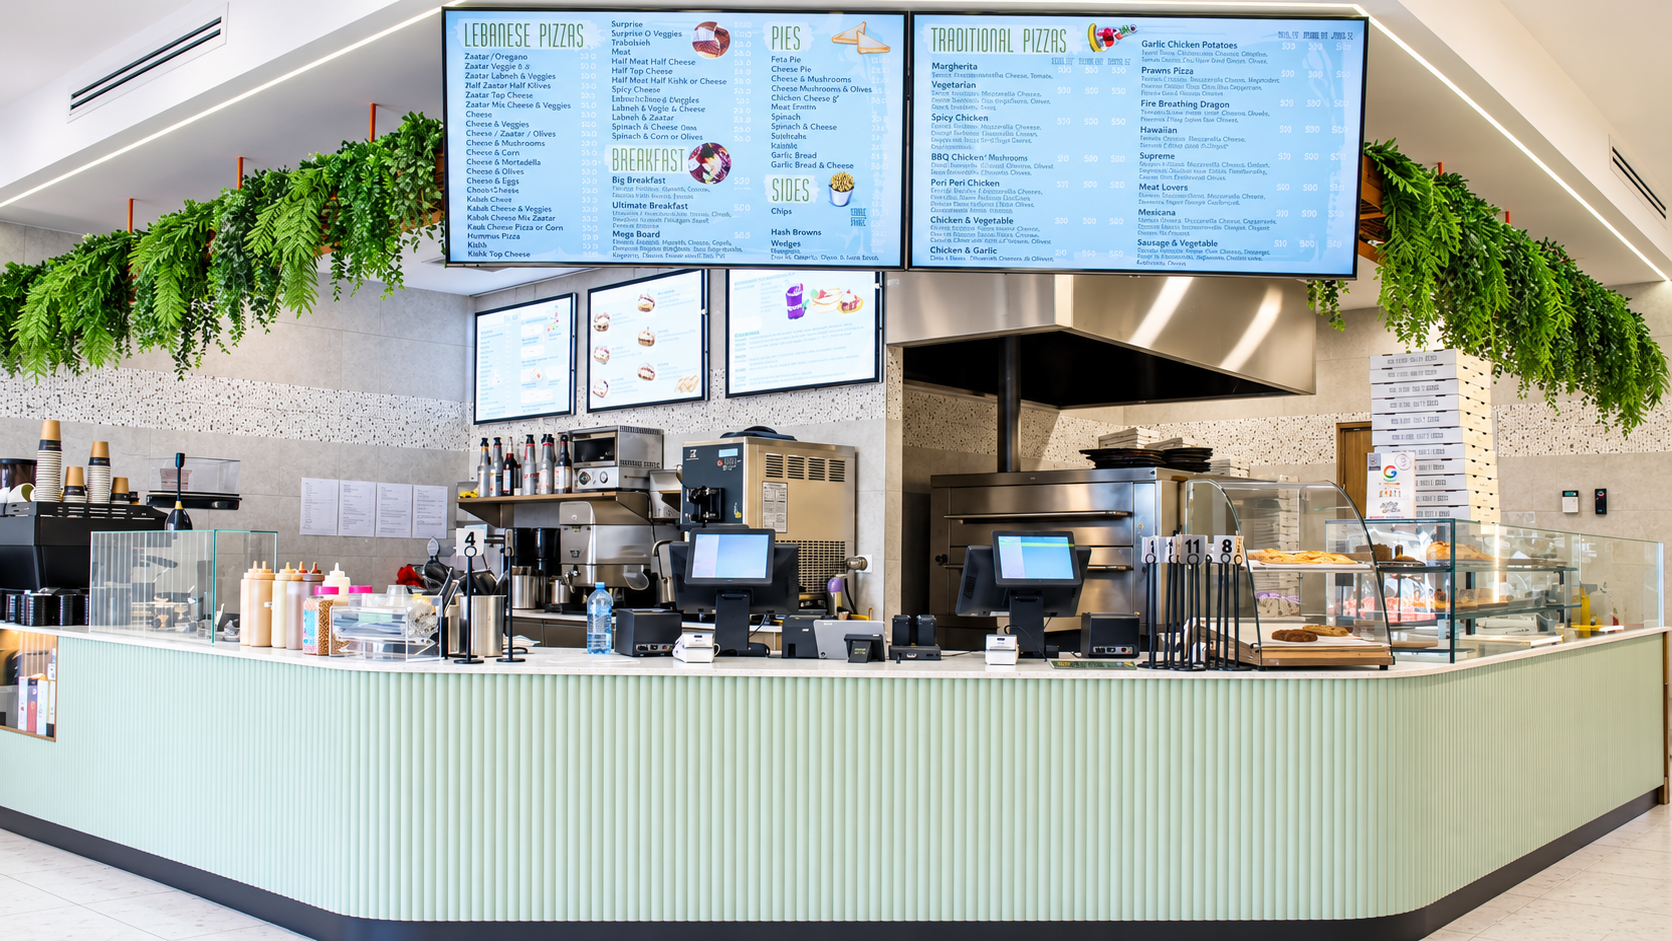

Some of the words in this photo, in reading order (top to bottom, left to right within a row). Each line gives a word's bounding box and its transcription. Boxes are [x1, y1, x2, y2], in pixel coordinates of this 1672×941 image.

[611, 20, 643, 28] Surprise
[464, 22, 530, 47] LEBANESE
[539, 23, 584, 47] PIZZAS
[611, 29, 643, 38] Surprise
[653, 30, 682, 39] Veggies
[771, 25, 801, 50] PIES
[931, 27, 1014, 52] TRADITIONAL
[1023, 28, 1067, 53] PIZZAS
[1141, 39, 1165, 48] Garlic
[1167, 40, 1200, 49] Chicken
[1202, 40, 1237, 49] Potatoes
[650, 57, 666, 65] Half
[771, 55, 787, 63] Feta
[789, 55, 801, 63] Pie
[629, 67, 644, 76] Top
[931, 62, 977, 72] Margherita
[1141, 66, 1171, 74] Prawns
[527, 72, 556, 81] Veggies
[650, 76, 666, 84] Half
[482, 81, 508, 89] Zaatar
[509, 81, 526, 89] Half
[611, 85, 632, 94] Spicy
[633, 85, 660, 93] Cheese
[771, 84, 798, 92] Cheese
[931, 80, 976, 90] Vegetarian
[491, 91, 505, 99] Top
[803, 94, 830, 102] Cheese
[465, 100, 490, 108] Zaatar
[542, 102, 571, 111] Veggies
[1140, 99, 1156, 107] Fire
[1158, 100, 1198, 109] Breathing
[1200, 100, 1229, 110] Dragon
[465, 110, 492, 118] Cheese
[612, 113, 639, 121] Labneh
[648, 113, 674, 121] Zaatar
[771, 112, 801, 121] Spinach
[931, 113, 953, 123] Spicy
[954, 113, 988, 121] Chicken
[501, 120, 529, 129] Veggies
[611, 123, 641, 131] Spinach
[771, 122, 800, 131] Spinach
[611, 132, 641, 141] Spinach
[612, 147, 684, 171] BREAKFAST
[794, 151, 817, 159] Bread
[931, 152, 949, 161] BBQ
[1139, 152, 1175, 161] Supreme
[770, 160, 792, 168] Garlic
[466, 167, 493, 175] Cheese
[501, 167, 524, 175] Olives
[612, 176, 624, 185] Big
[627, 176, 665, 184] Breakfast
[930, 178, 946, 187] Peri
[949, 178, 965, 187] Peri
[772, 178, 810, 202] SIDES
[1161, 183, 1188, 191] Lovers
[524, 205, 552, 214] Veggies
[612, 201, 647, 209] Ultimate
[770, 207, 792, 216] Chips
[1138, 208, 1175, 216] Mexicana
[973, 216, 1013, 226] Vegetable
[545, 223, 563, 231] Corn
[612, 230, 634, 239] Mega
[770, 240, 801, 248] Wedges
[1137, 238, 1170, 248] Sausage
[1179, 239, 1218, 249] Vegetable
[489, 250, 503, 259] Top
[930, 246, 962, 254] Chicken
[973, 246, 997, 254] Garlic
[465, 532, 476, 545] 4
[1185, 539, 1200, 554] 11
[1222, 539, 1232, 553] 8
